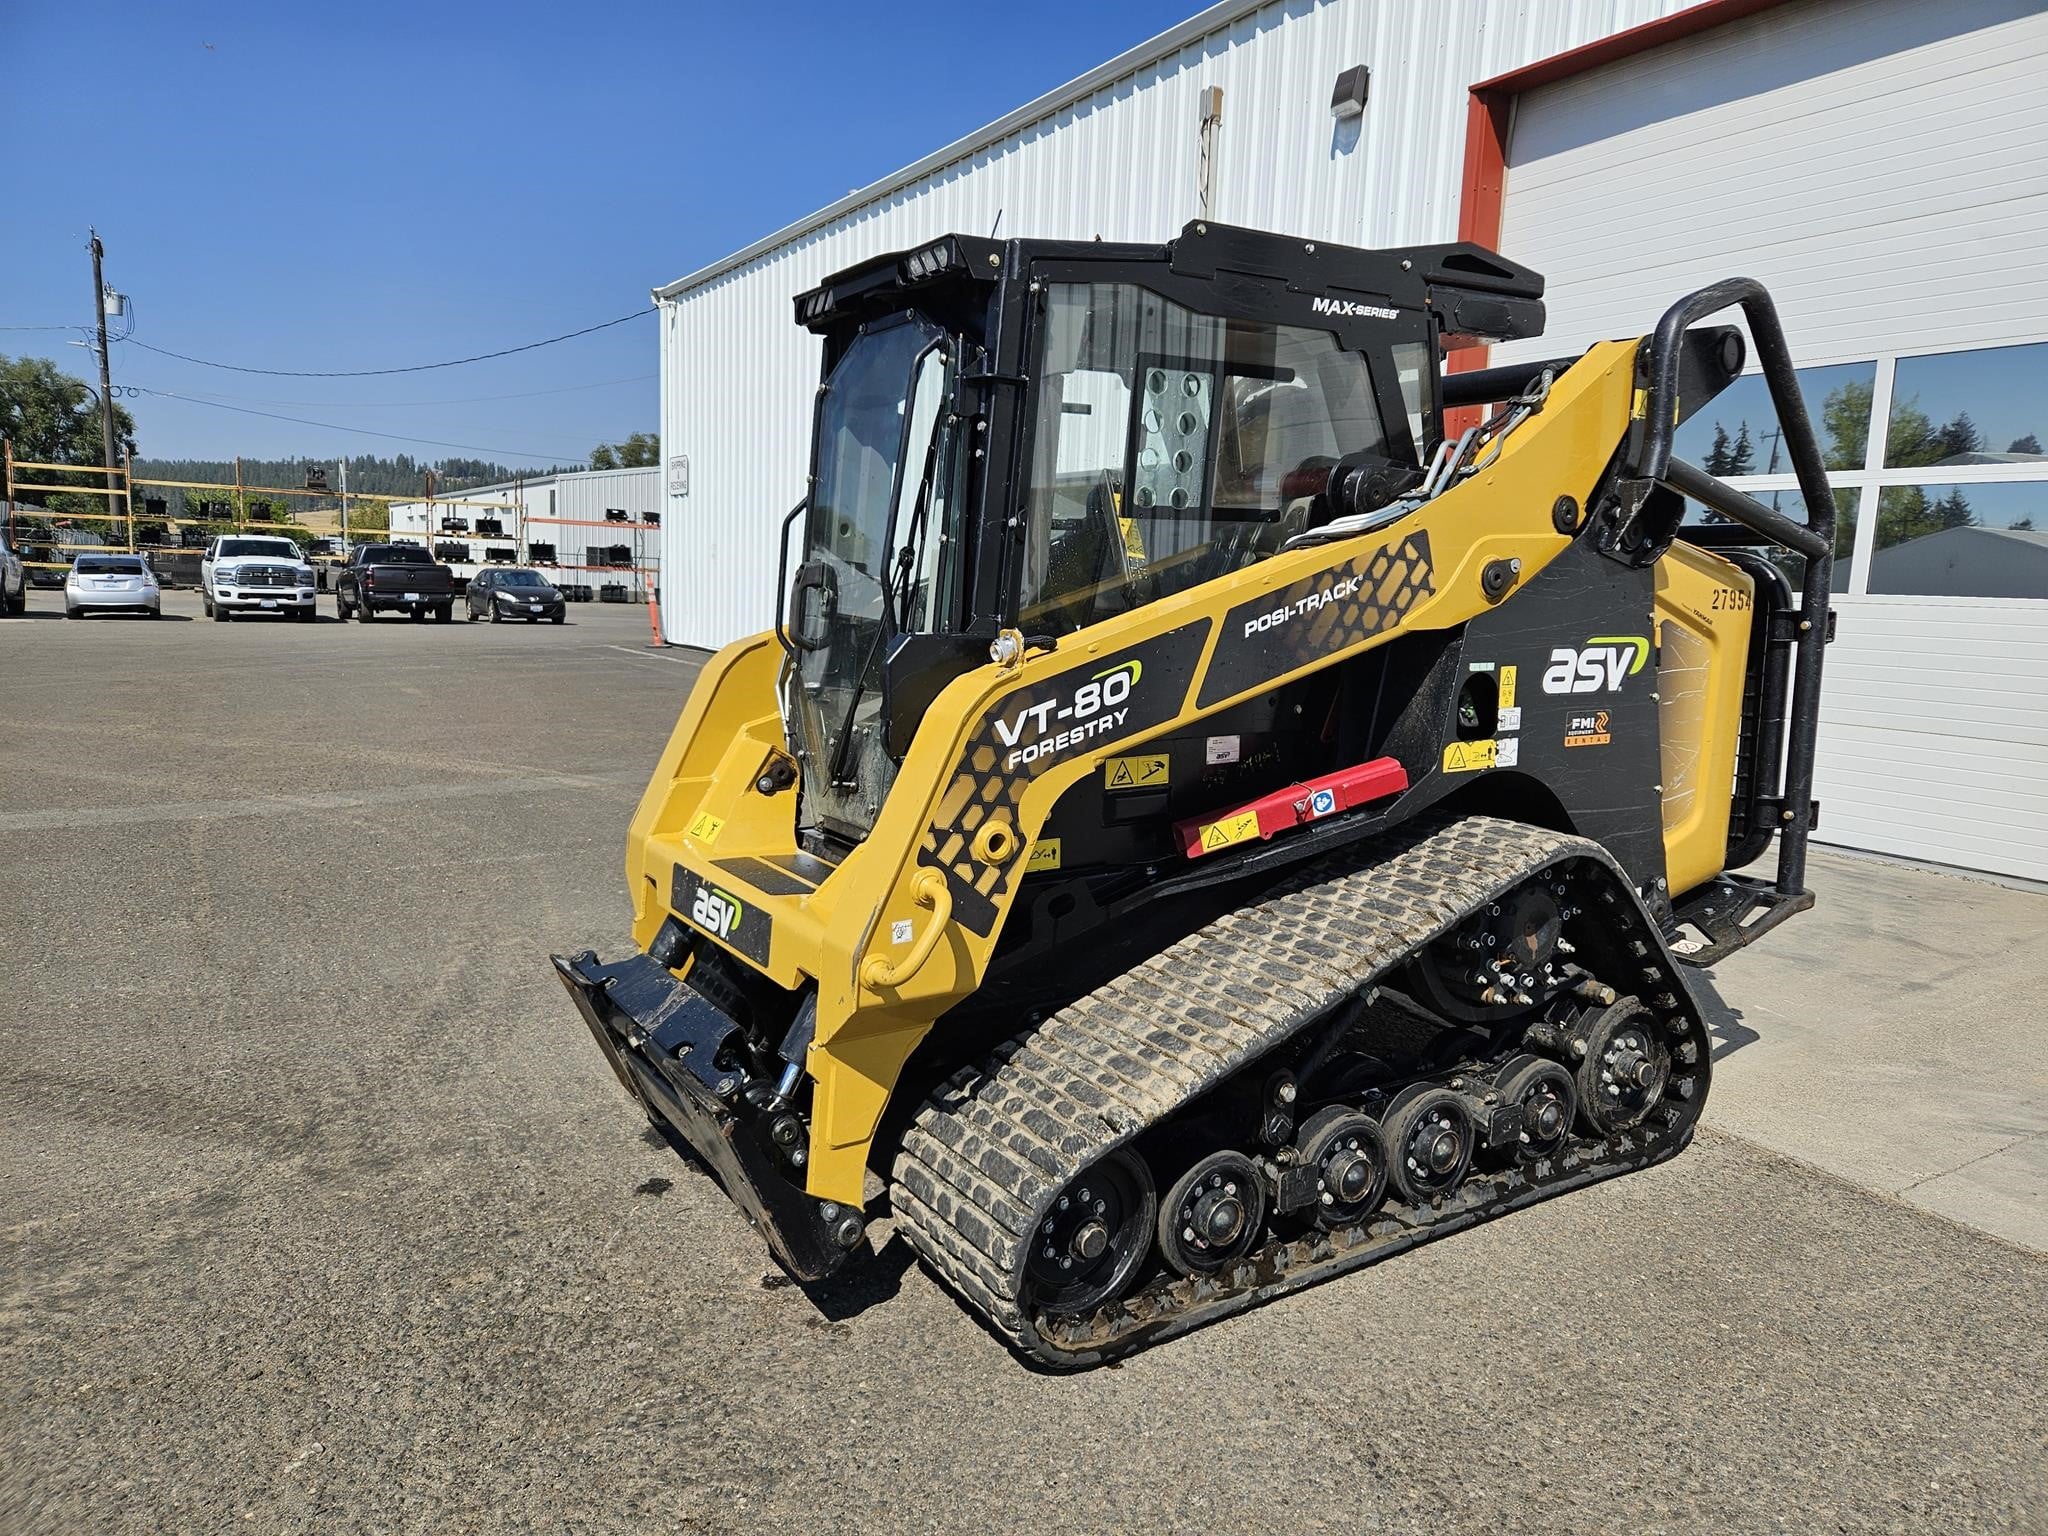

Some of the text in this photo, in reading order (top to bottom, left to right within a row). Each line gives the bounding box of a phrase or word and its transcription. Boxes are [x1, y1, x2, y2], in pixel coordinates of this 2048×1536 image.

[1312, 297, 1399, 319] MAX-SERIES
[1712, 589, 1751, 611] 27954
[994, 671, 1131, 747] VT-80
[1572, 717, 1595, 729] FMI
[1008, 708, 1129, 770] FORESTRY
